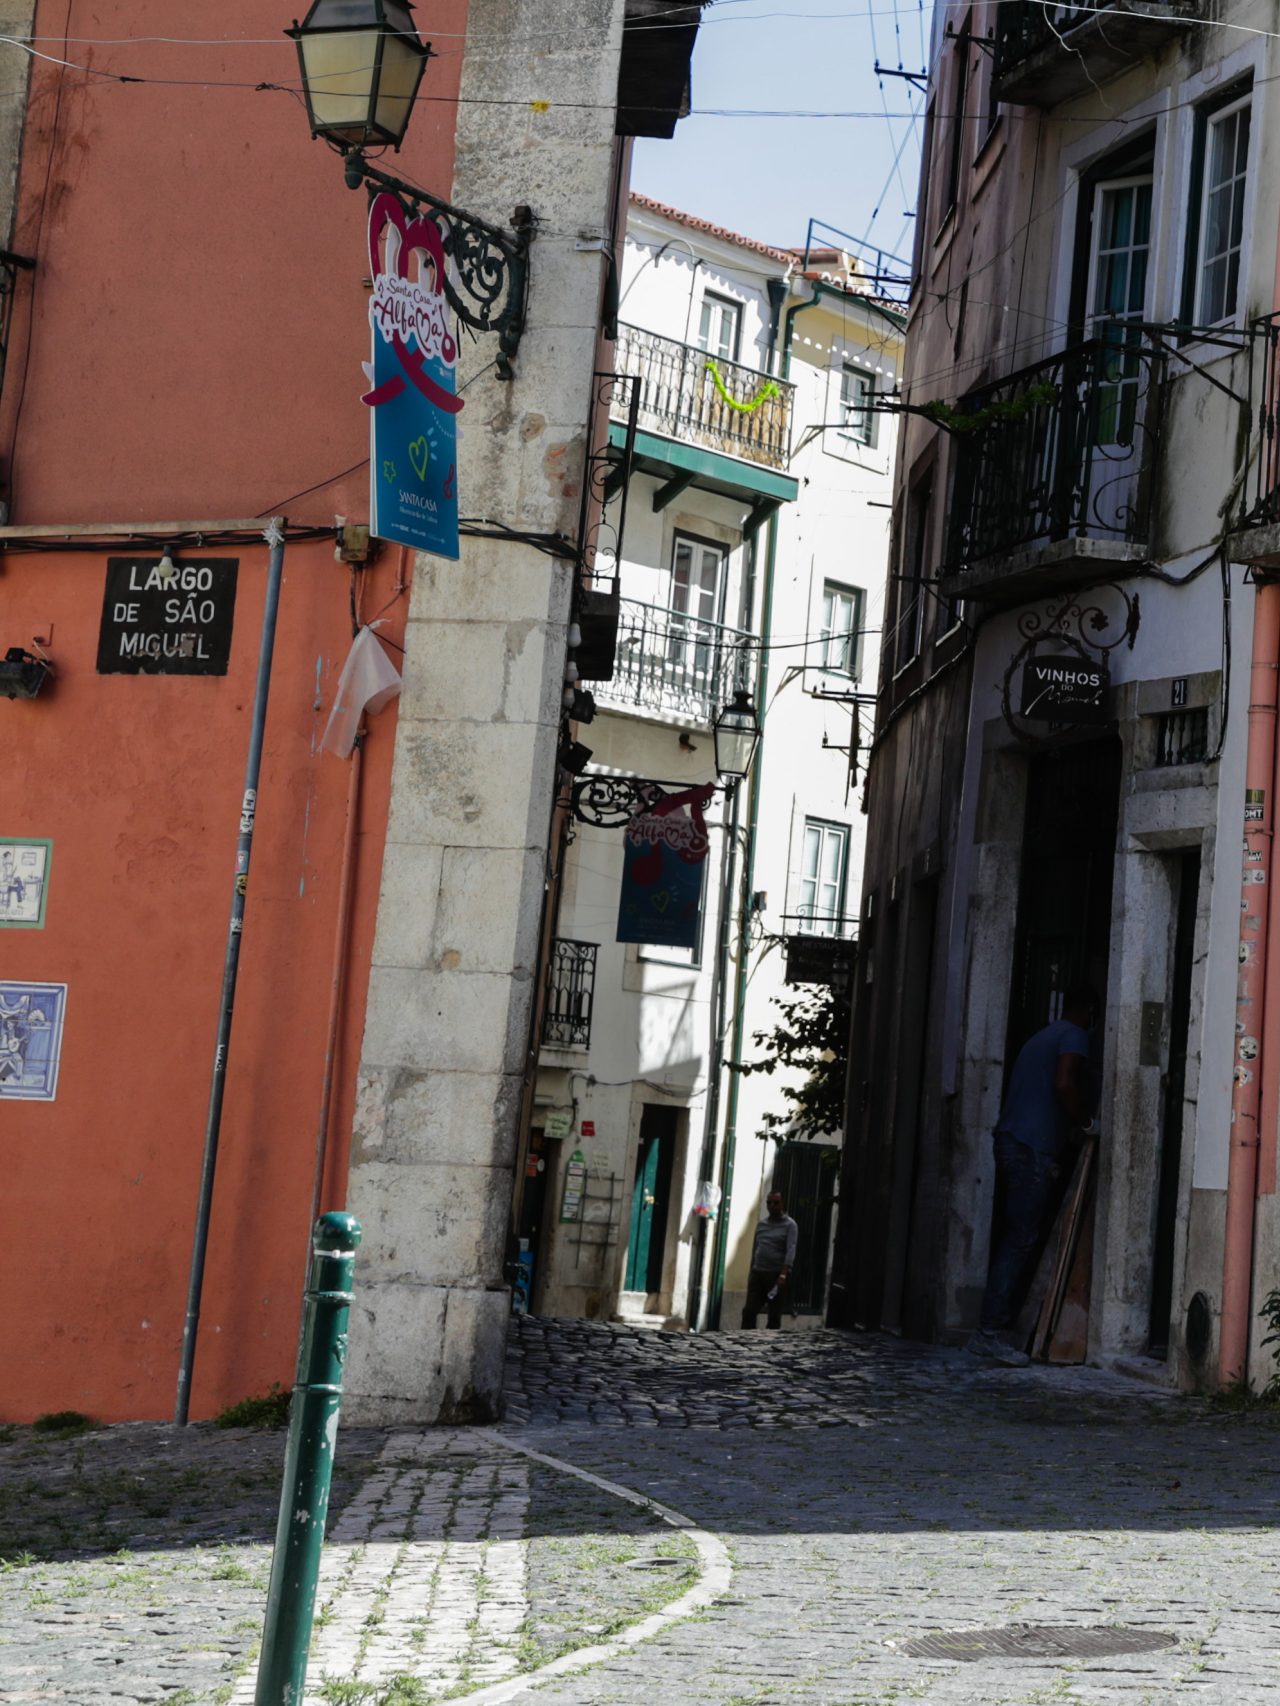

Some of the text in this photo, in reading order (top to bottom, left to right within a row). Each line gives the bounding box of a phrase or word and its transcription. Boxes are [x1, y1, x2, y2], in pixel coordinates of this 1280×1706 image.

[387, 278, 433, 306] Santa Casa
[399, 489, 438, 512] SANTA CASA
[129, 566, 213, 591] LARGO
[113, 592, 215, 623] DE SÃO
[1036, 667, 1100, 687] VINHOS
[1061, 684, 1074, 692] DO
[1174, 680, 1185, 704] 21
